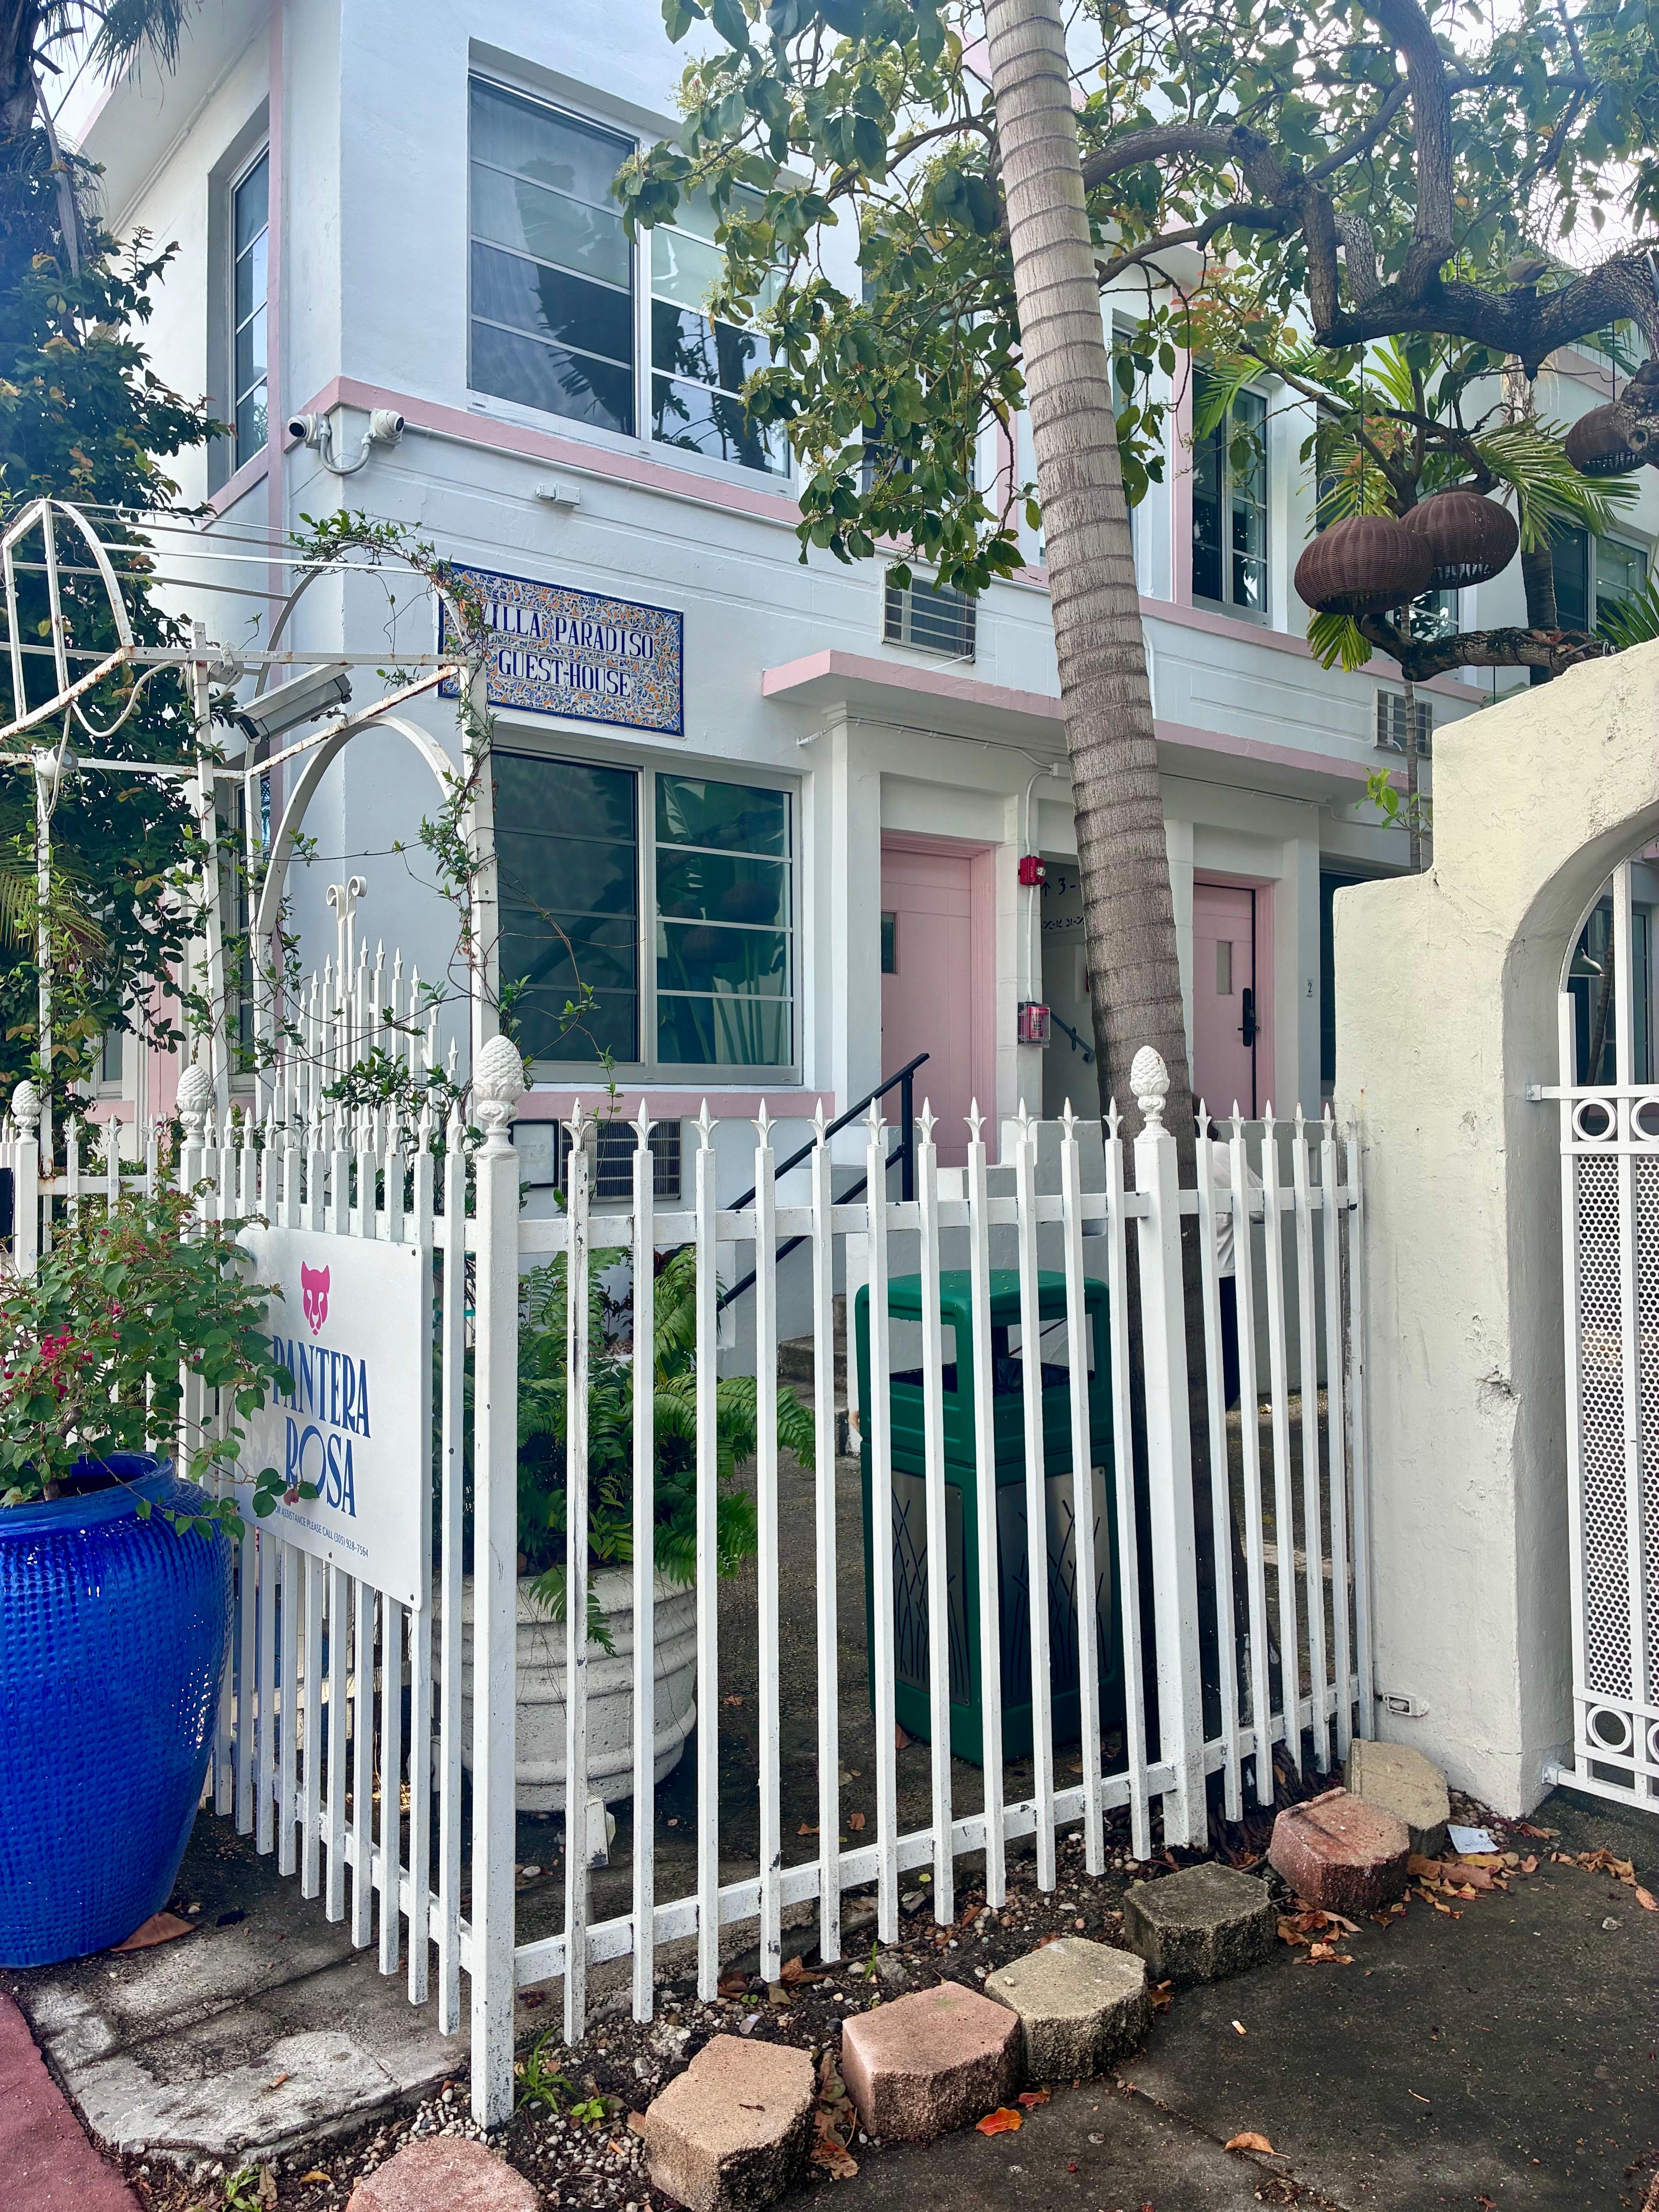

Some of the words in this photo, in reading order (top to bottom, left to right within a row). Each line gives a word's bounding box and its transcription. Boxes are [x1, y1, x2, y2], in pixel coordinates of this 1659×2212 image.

[555, 617, 654, 659] PARADISO
[498, 649, 631, 697] GUEST-HOUSE
[1308, 982, 1312, 993] 2
[272, 1335, 371, 1438] PANTERA
[285, 1416, 357, 1518] ROSA
[282, 1510, 306, 1526] ASSISTANCE
[307, 1519, 322, 1534] PLEASE
[323, 1527, 333, 1540] CALL
[334, 1533, 345, 1547] (305)
[346, 1539, 369, 1558] 928-7564
